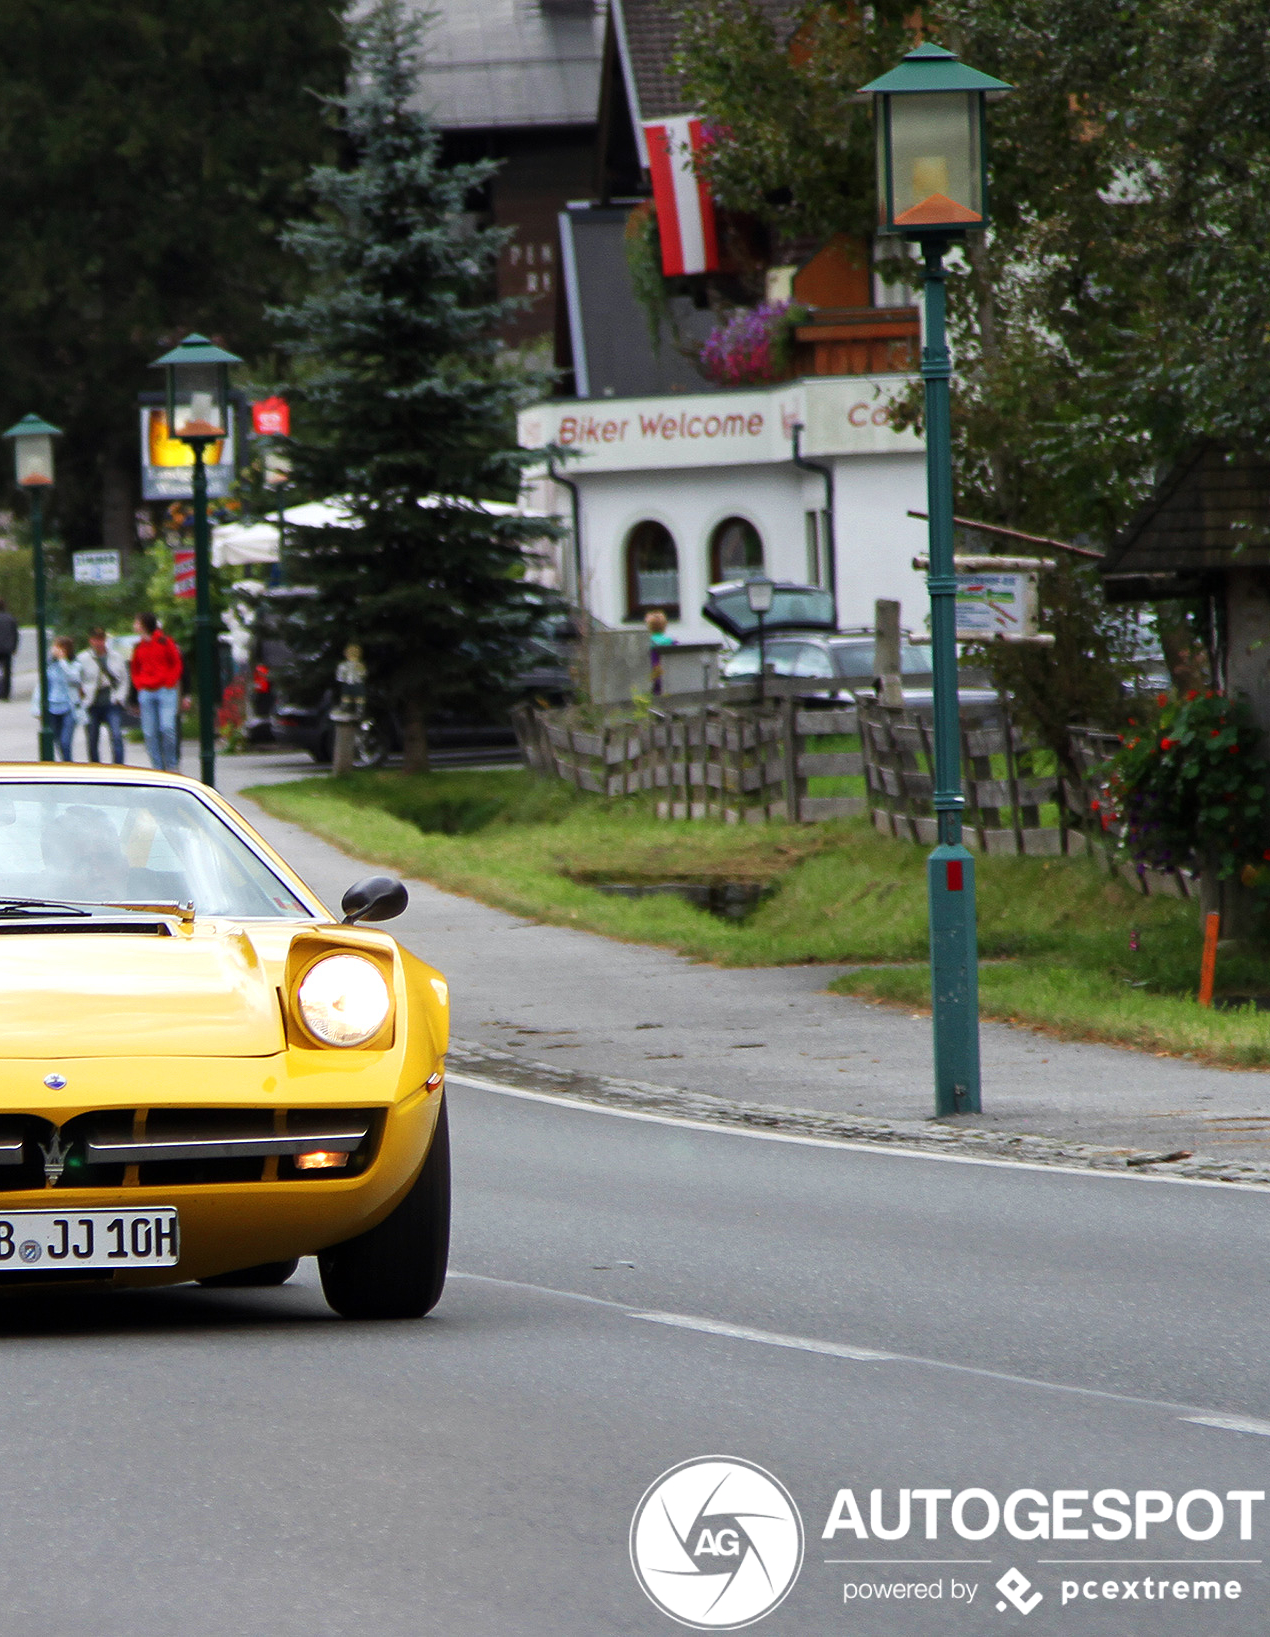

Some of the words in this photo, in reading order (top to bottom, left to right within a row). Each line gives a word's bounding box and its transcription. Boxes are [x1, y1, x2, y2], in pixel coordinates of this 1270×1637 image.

[559, 416, 628, 445] Biker
[638, 411, 764, 440] Welcome
[47, 1219, 94, 1260] JJ
[106, 1217, 177, 1258] 10H
